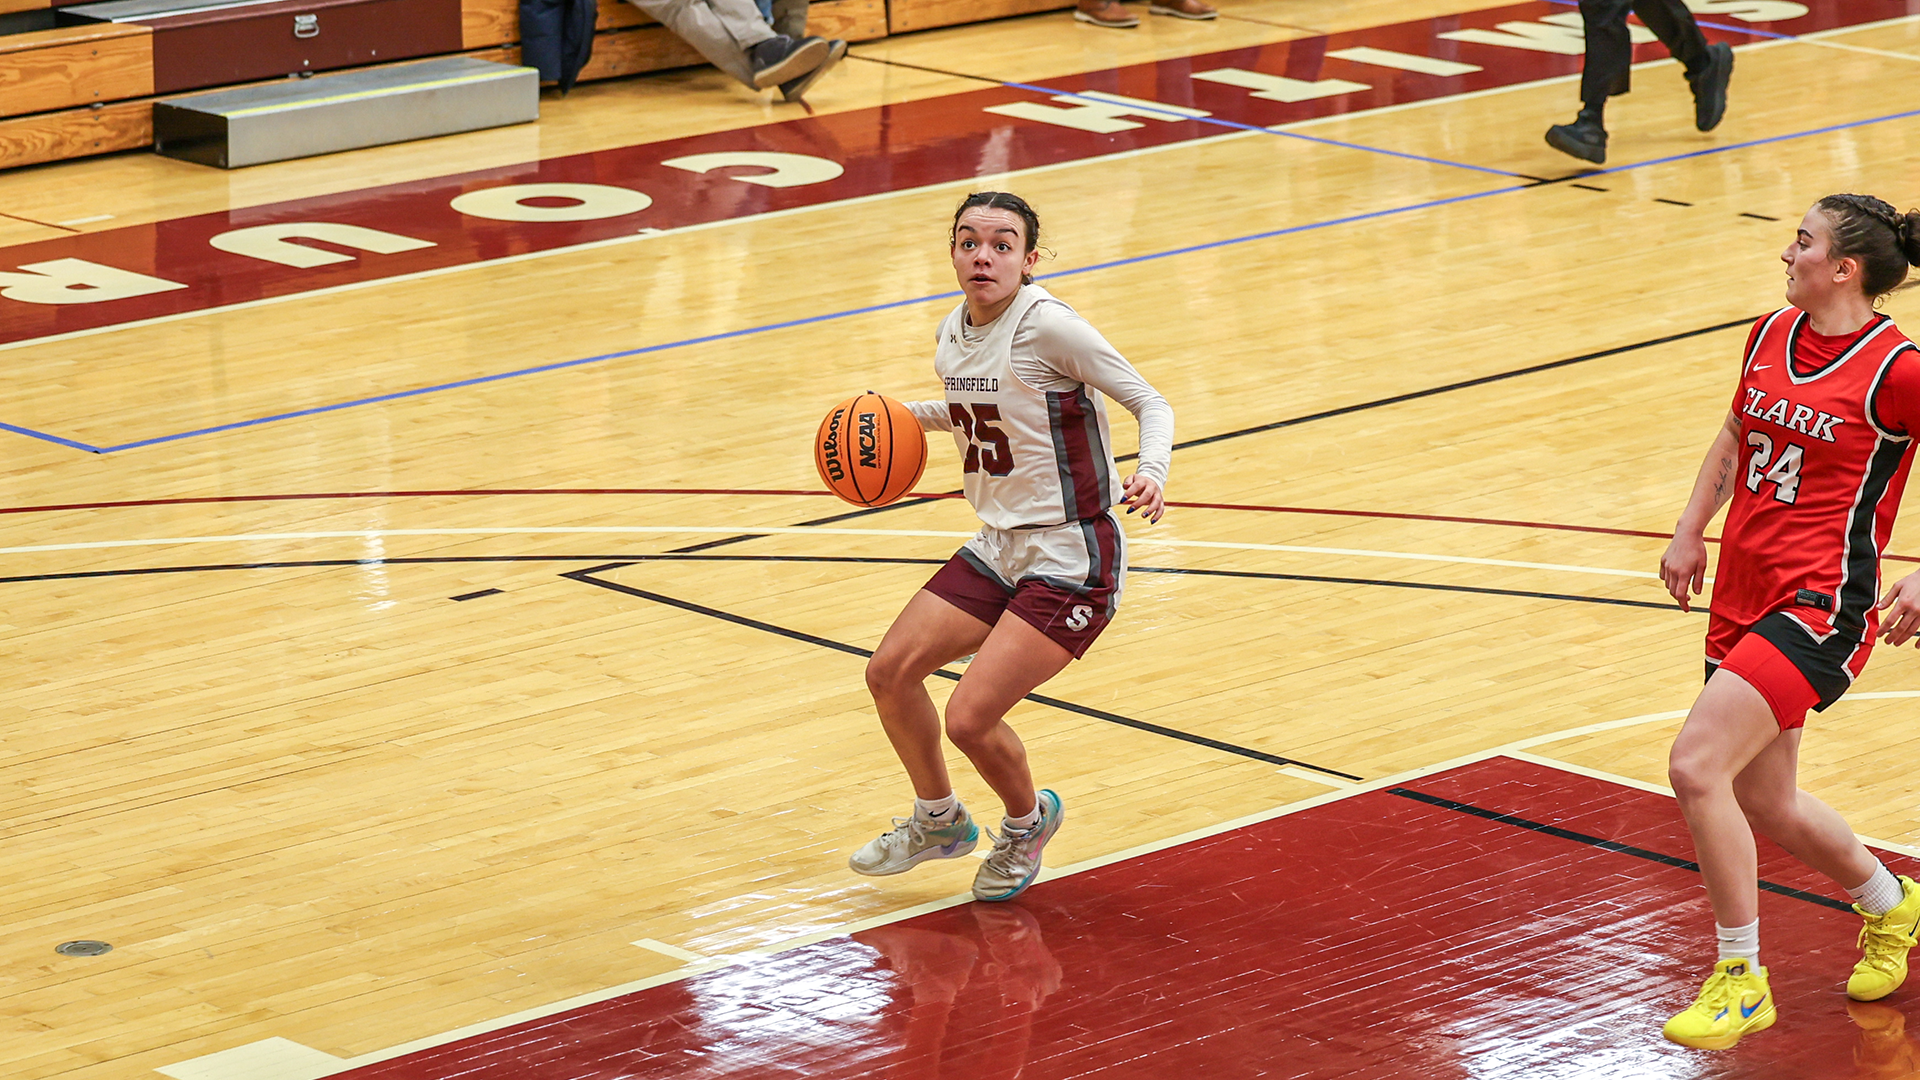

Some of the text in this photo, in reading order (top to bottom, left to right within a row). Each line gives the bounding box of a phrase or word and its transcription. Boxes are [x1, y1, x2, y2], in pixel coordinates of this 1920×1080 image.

[983, 0, 1809, 134] SMITH
[824, 408, 846, 483] Wilson
[859, 412, 877, 469] NCAA
[1742, 387, 1845, 443] CLARK
[1746, 429, 1805, 505] 24
[1065, 604, 1093, 632] S
